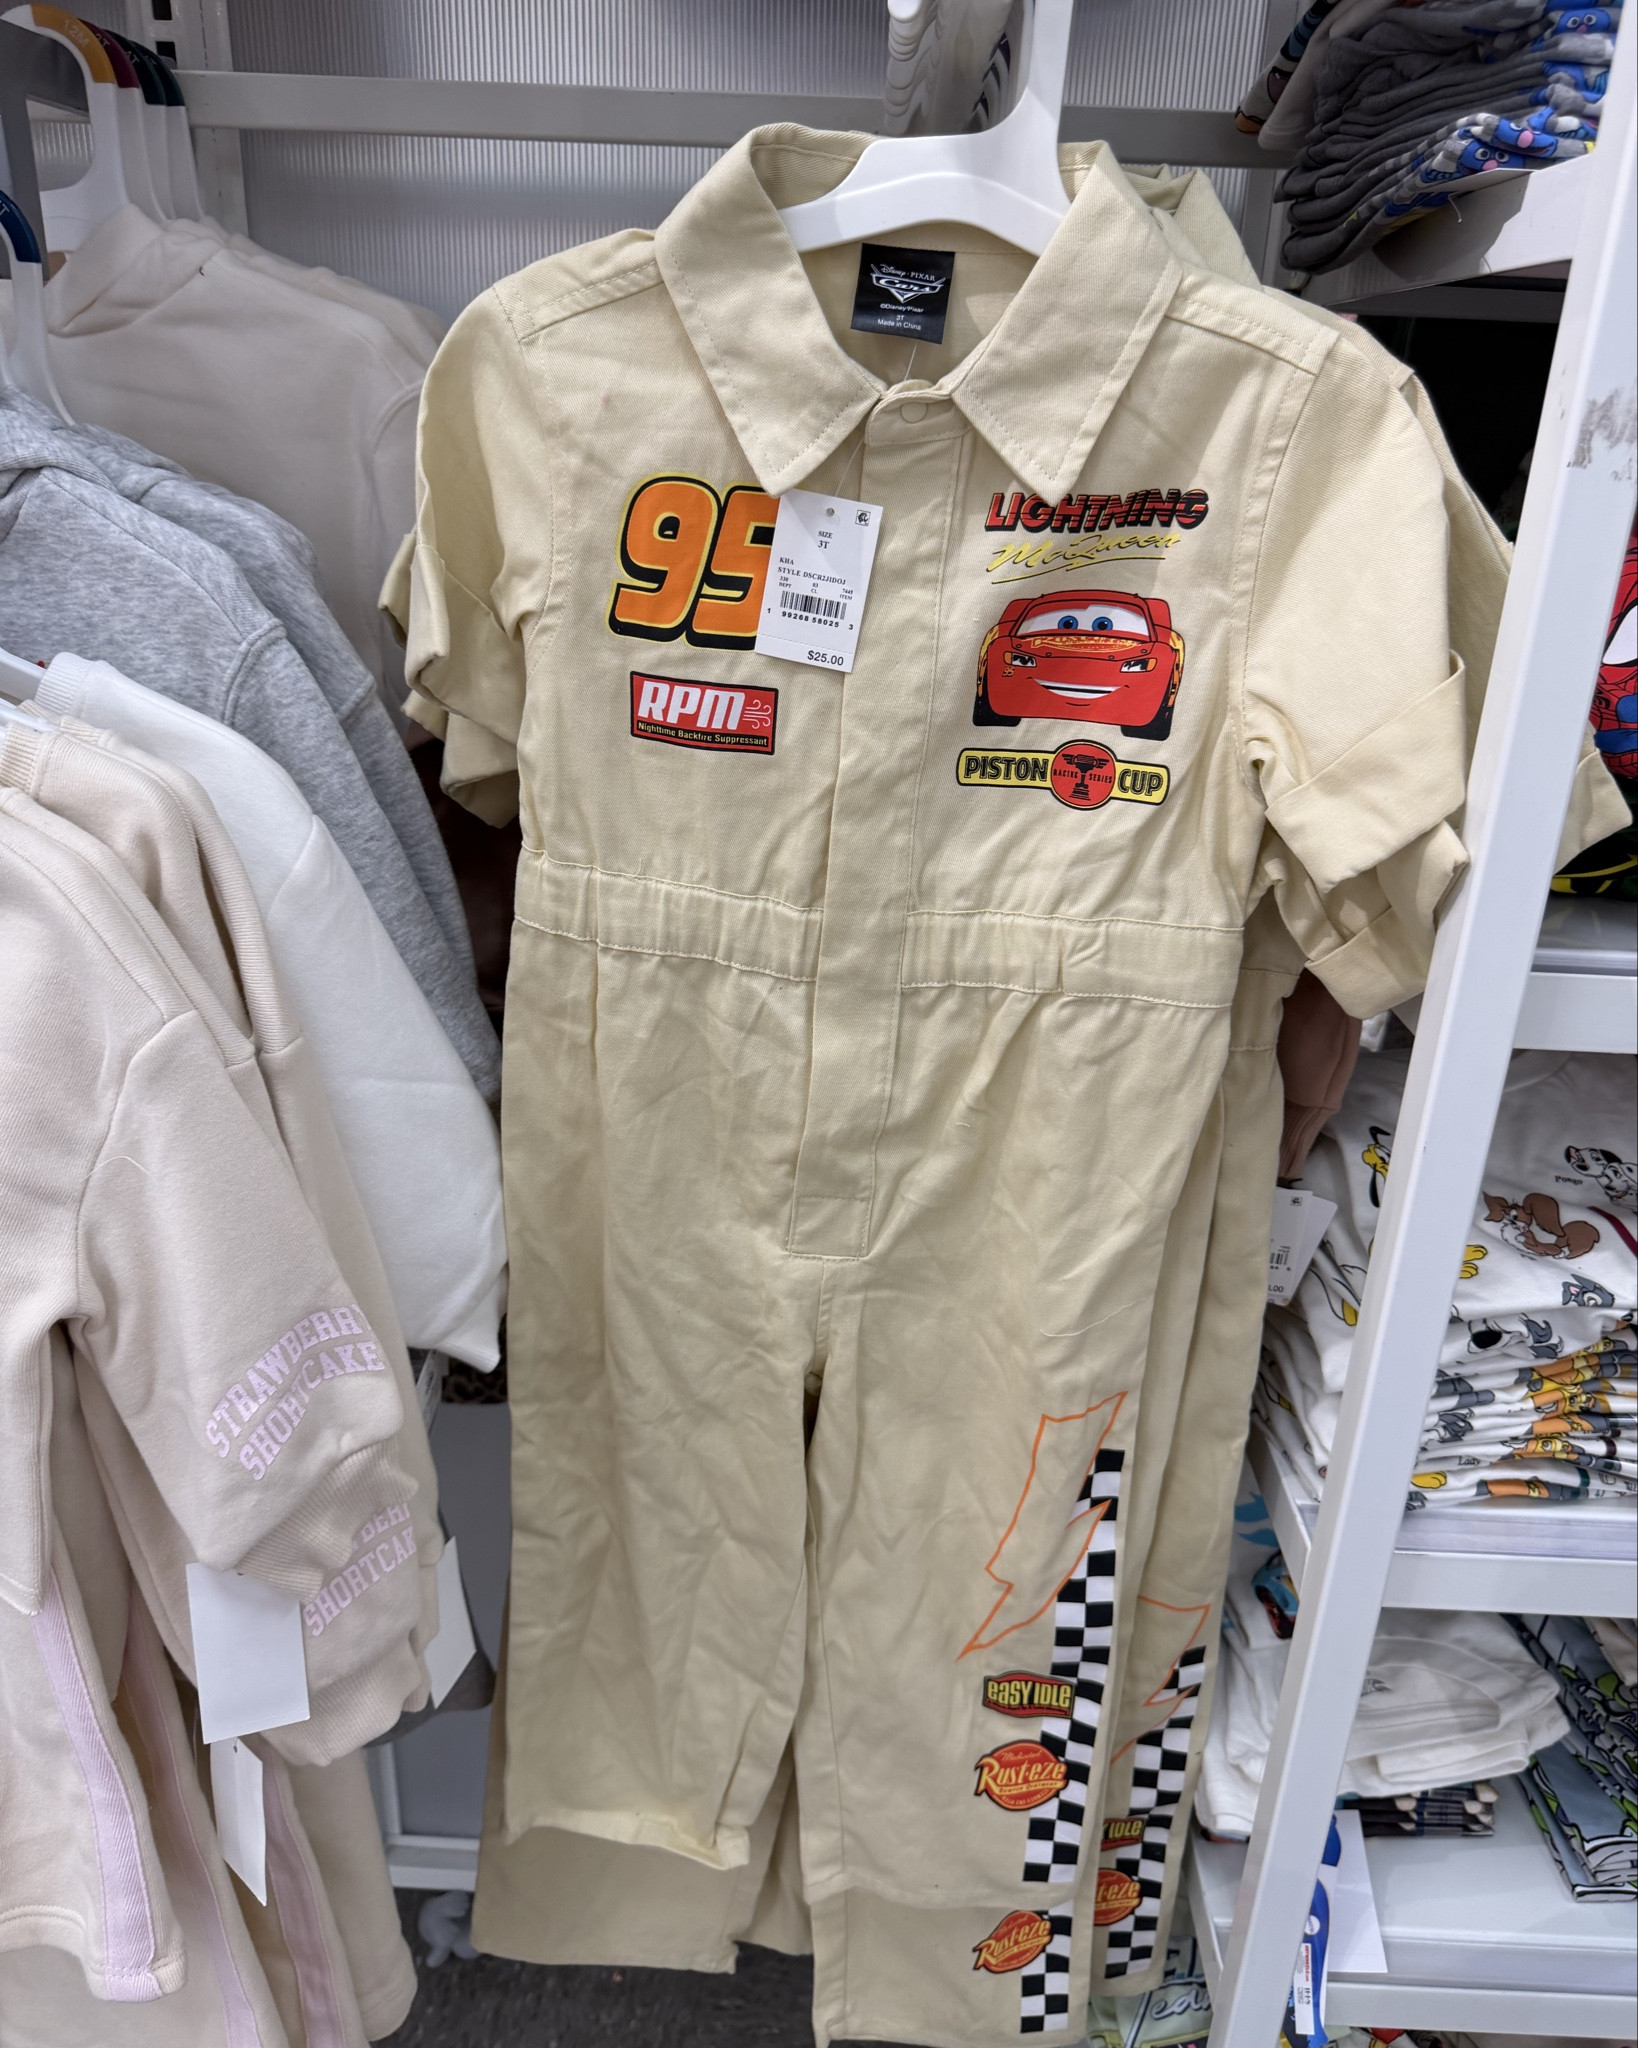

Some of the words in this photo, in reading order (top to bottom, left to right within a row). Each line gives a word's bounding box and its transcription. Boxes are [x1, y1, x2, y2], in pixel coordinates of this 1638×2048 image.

[880, 264, 906, 277] Disney
[910, 272, 935, 281] PIXAR
[880, 279, 931, 292] Cars
[904, 321, 921, 330] China
[984, 488, 1209, 533] LIGHTNING
[818, 531, 833, 539] SIZE
[818, 540, 830, 550] 3T
[606, 473, 782, 651] 95
[986, 533, 1181, 575] McQueen
[778, 567, 801, 577] STYLE
[807, 650, 844, 666] $25.00
[637, 680, 746, 731] RPM
[638, 722, 676, 736] Nighttime
[678, 730, 713, 742] Backfire
[714, 734, 768, 746] Suppressant
[964, 755, 1048, 782] PISTON
[1053, 768, 1079, 779] RACING
[1088, 773, 1113, 784] SERIES
[1118, 768, 1164, 797] CUP
[239, 1341, 386, 1481] SHORTCAKE
[1458, 1455, 1480, 1466] Lady
